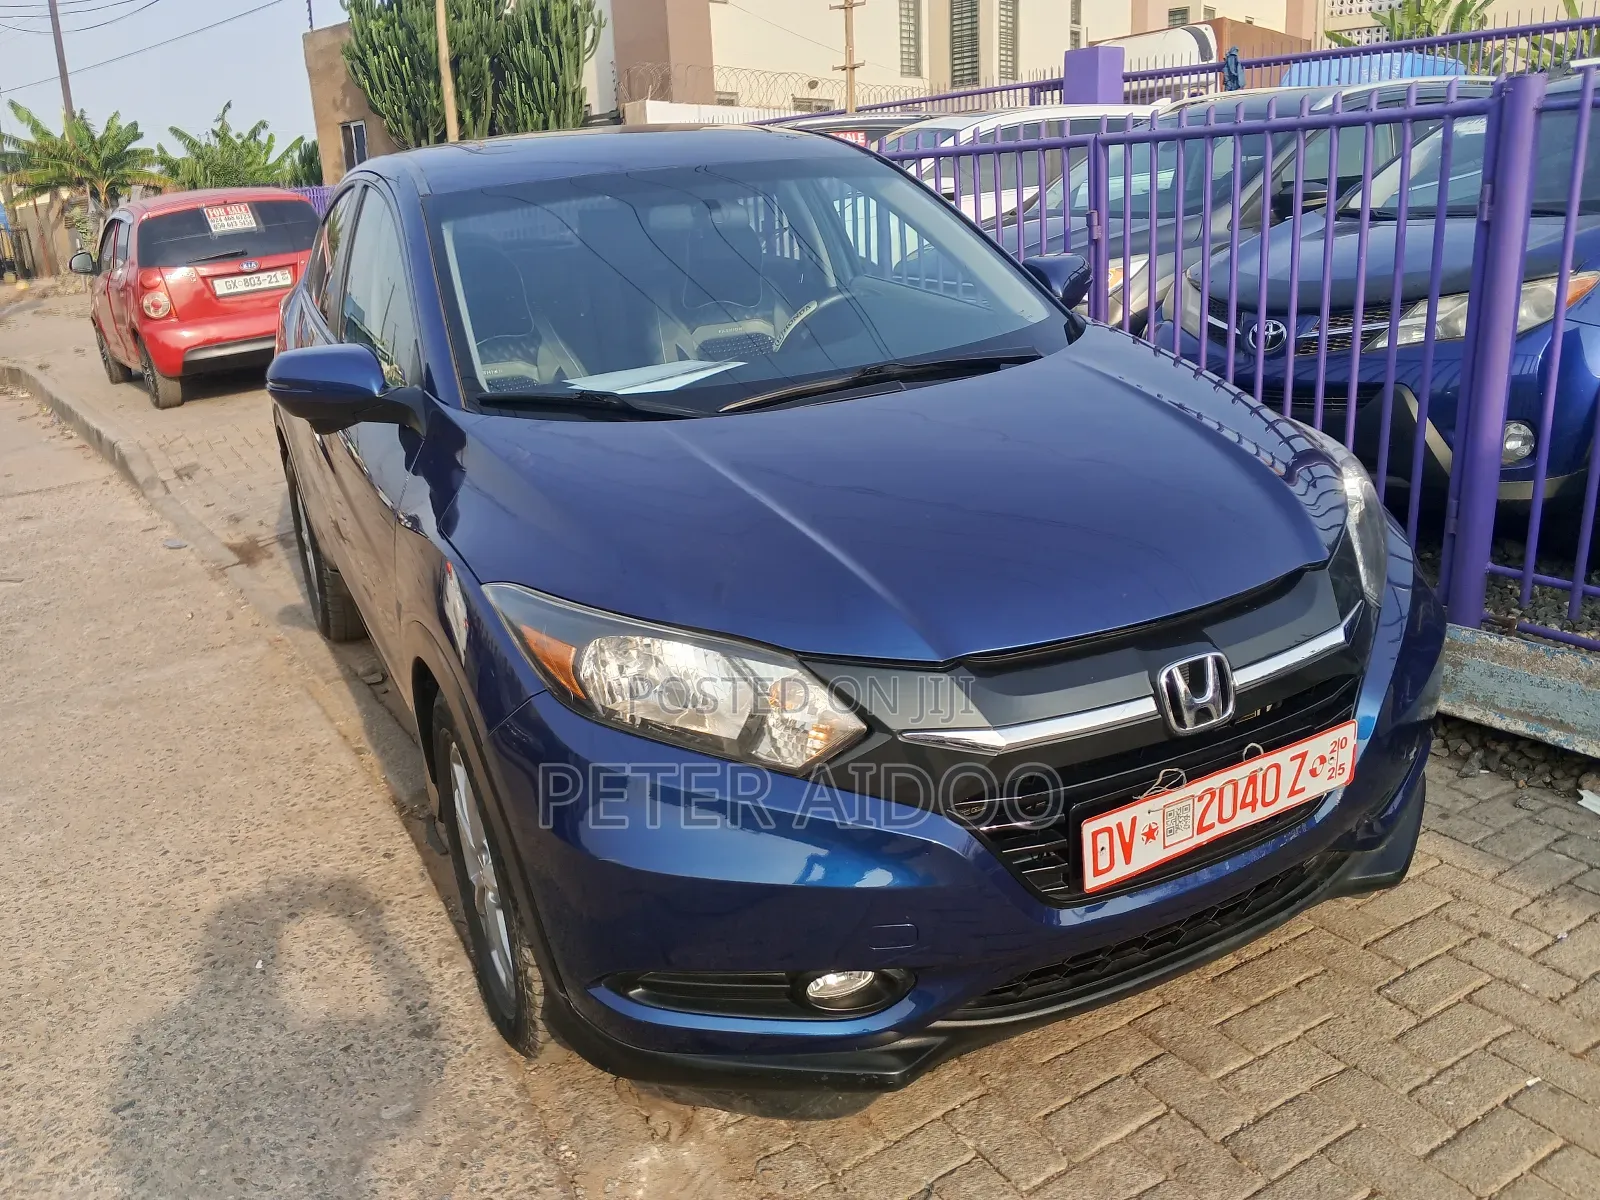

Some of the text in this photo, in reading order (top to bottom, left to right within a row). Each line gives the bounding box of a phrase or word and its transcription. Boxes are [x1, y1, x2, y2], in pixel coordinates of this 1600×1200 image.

[839, 132, 865, 144] SALE
[208, 203, 249, 217] FOR SALE
[242, 261, 257, 269] KIA
[224, 279, 238, 290] GX
[782, 305, 812, 333] HONDA
[718, 326, 743, 334] FASHION
[1091, 750, 1309, 878] DV 2040 Z
